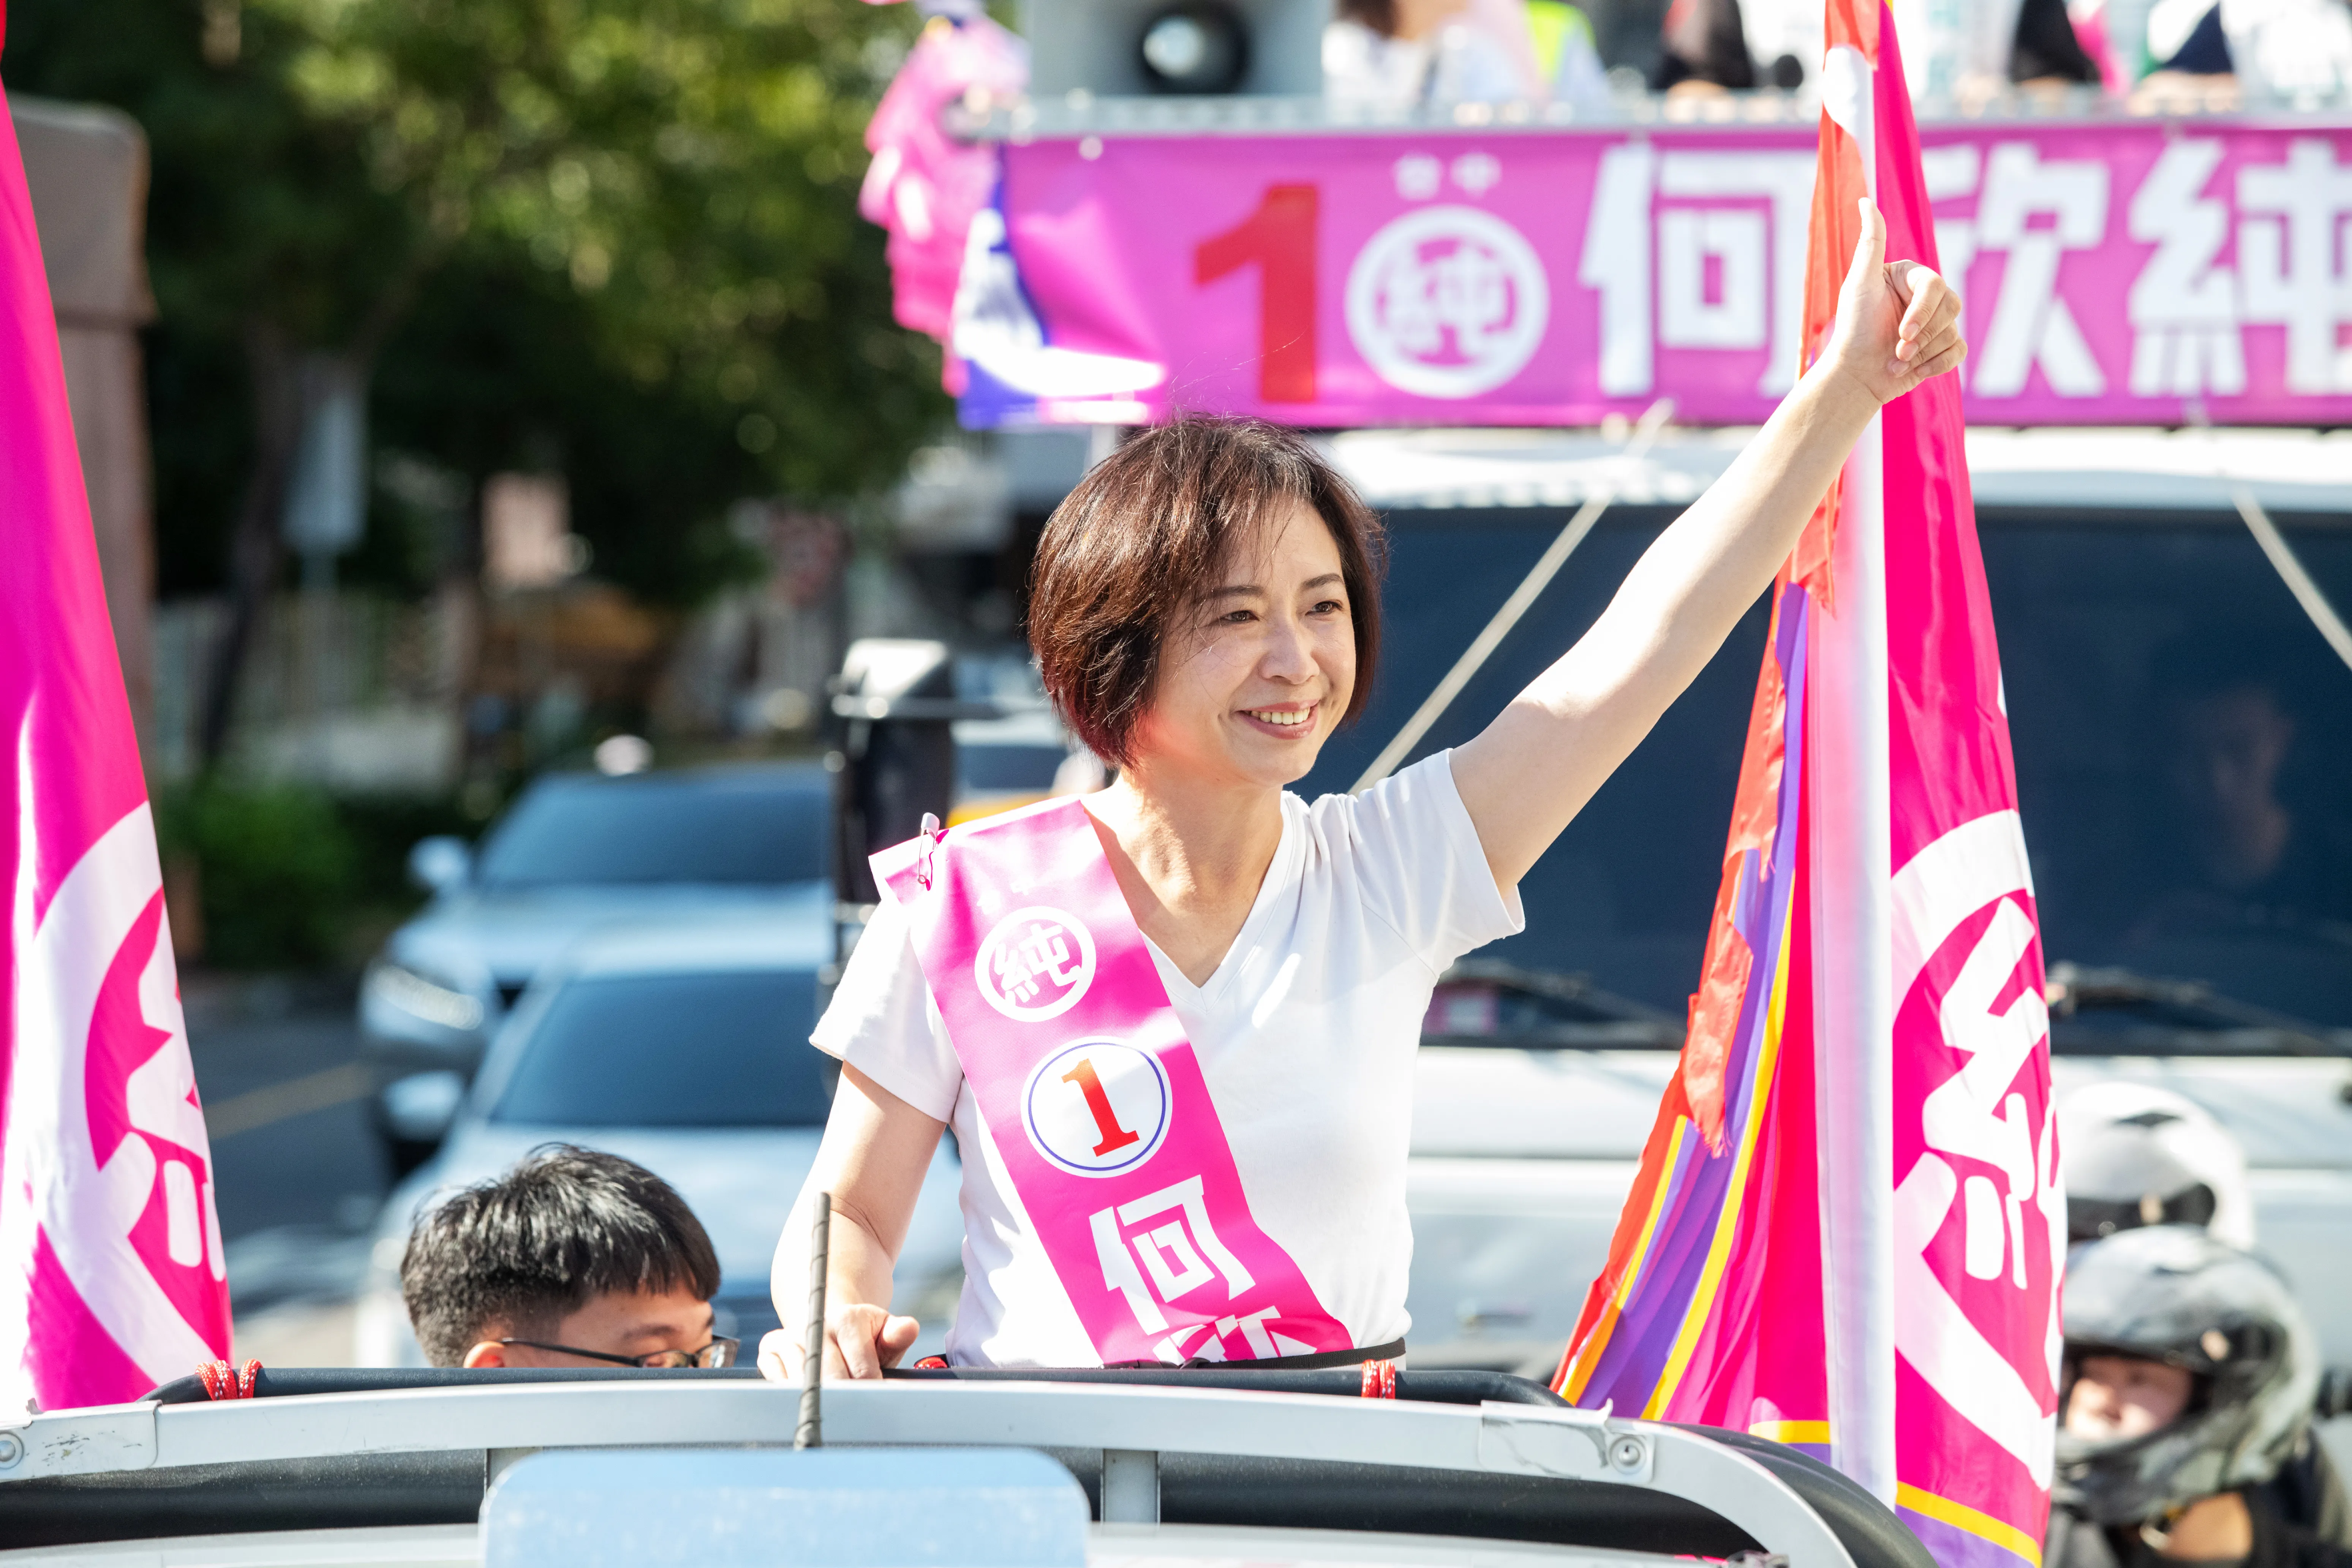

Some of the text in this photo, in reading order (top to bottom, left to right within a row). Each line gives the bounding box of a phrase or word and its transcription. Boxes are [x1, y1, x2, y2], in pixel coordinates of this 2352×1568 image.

[1192, 184, 1320, 403] 1
[991, 922, 1086, 1010] 純
[1061, 1058, 1140, 1157] 1
